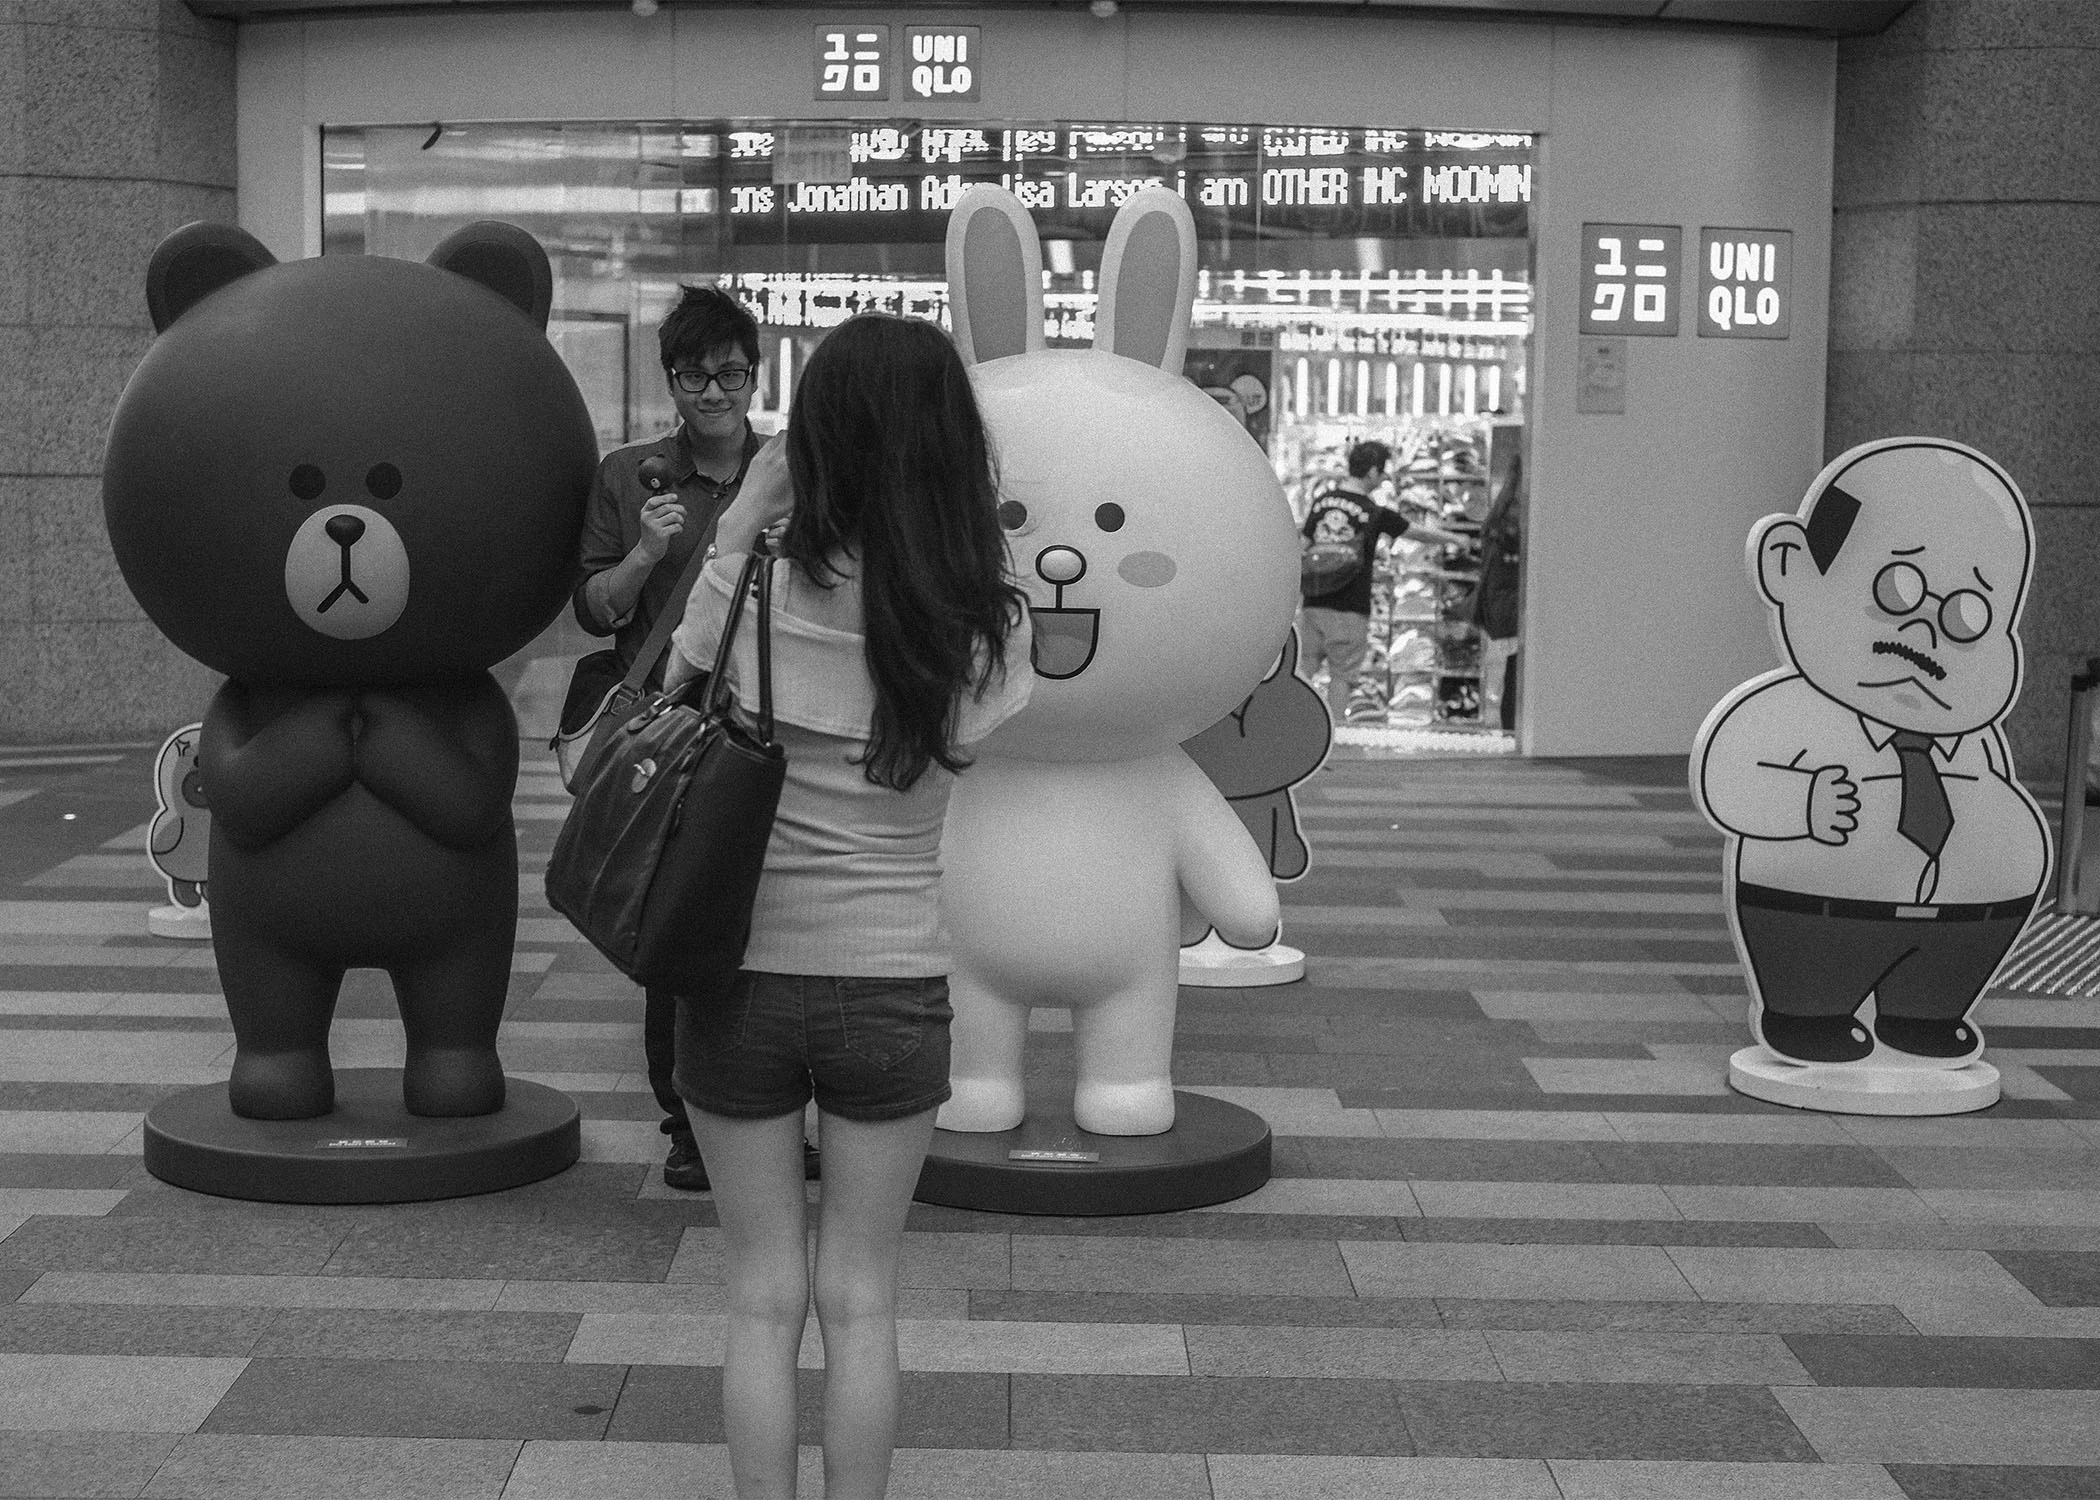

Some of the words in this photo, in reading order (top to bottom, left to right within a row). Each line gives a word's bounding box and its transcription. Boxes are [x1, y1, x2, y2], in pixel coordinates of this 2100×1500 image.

[912, 34, 968, 63] UNI
[911, 66, 972, 97] QLO
[787, 177, 909, 212] Jonathan
[1199, 178, 1248, 206] am
[1262, 168, 1348, 206] OTHER
[1709, 241, 1776, 282] UNI
[1708, 285, 1780, 331] QLO
